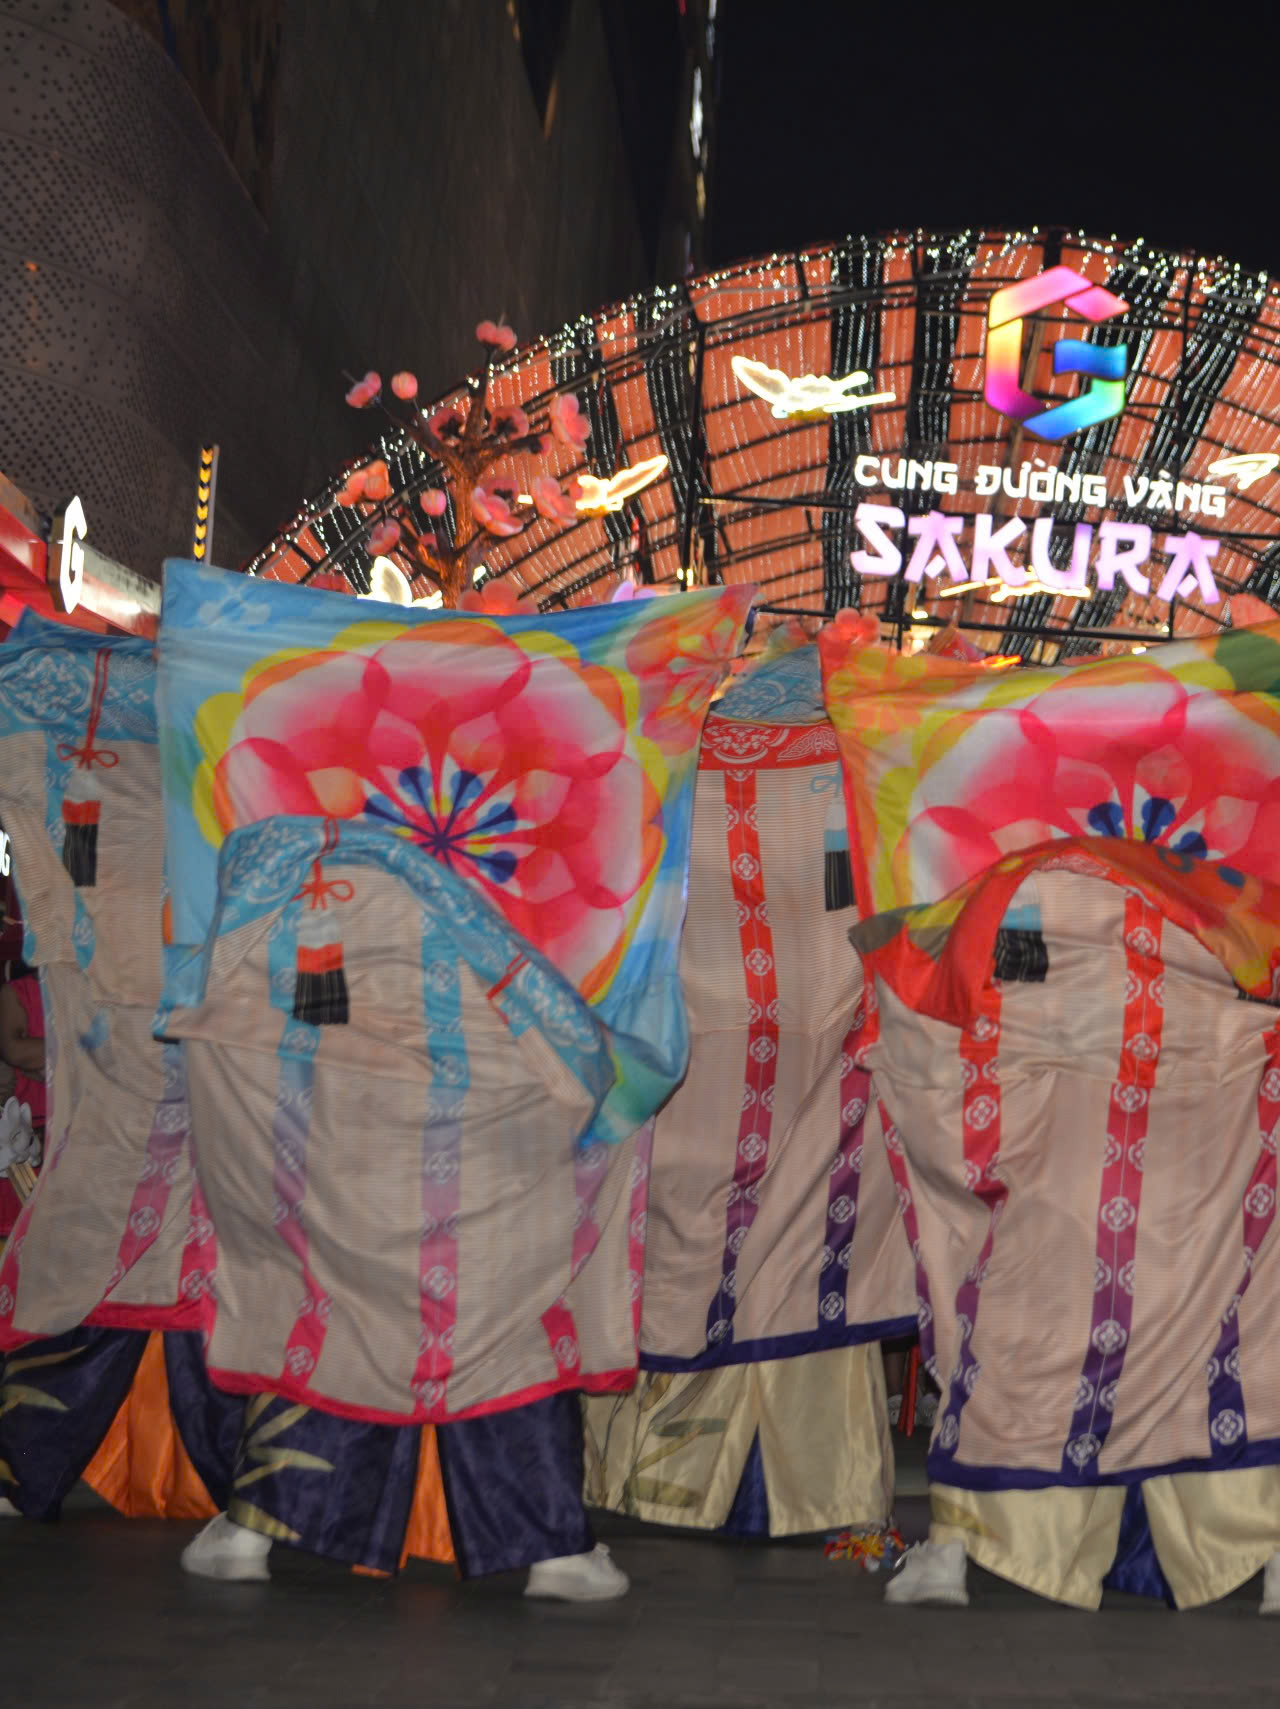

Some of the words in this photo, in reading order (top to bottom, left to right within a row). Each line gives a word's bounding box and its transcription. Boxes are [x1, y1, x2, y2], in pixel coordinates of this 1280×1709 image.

[854, 455, 959, 496] CUNG
[974, 457, 1107, 508] ĐƯỜNG
[1123, 470, 1227, 518] VÀNG
[850, 502, 1221, 605] SAKURA
